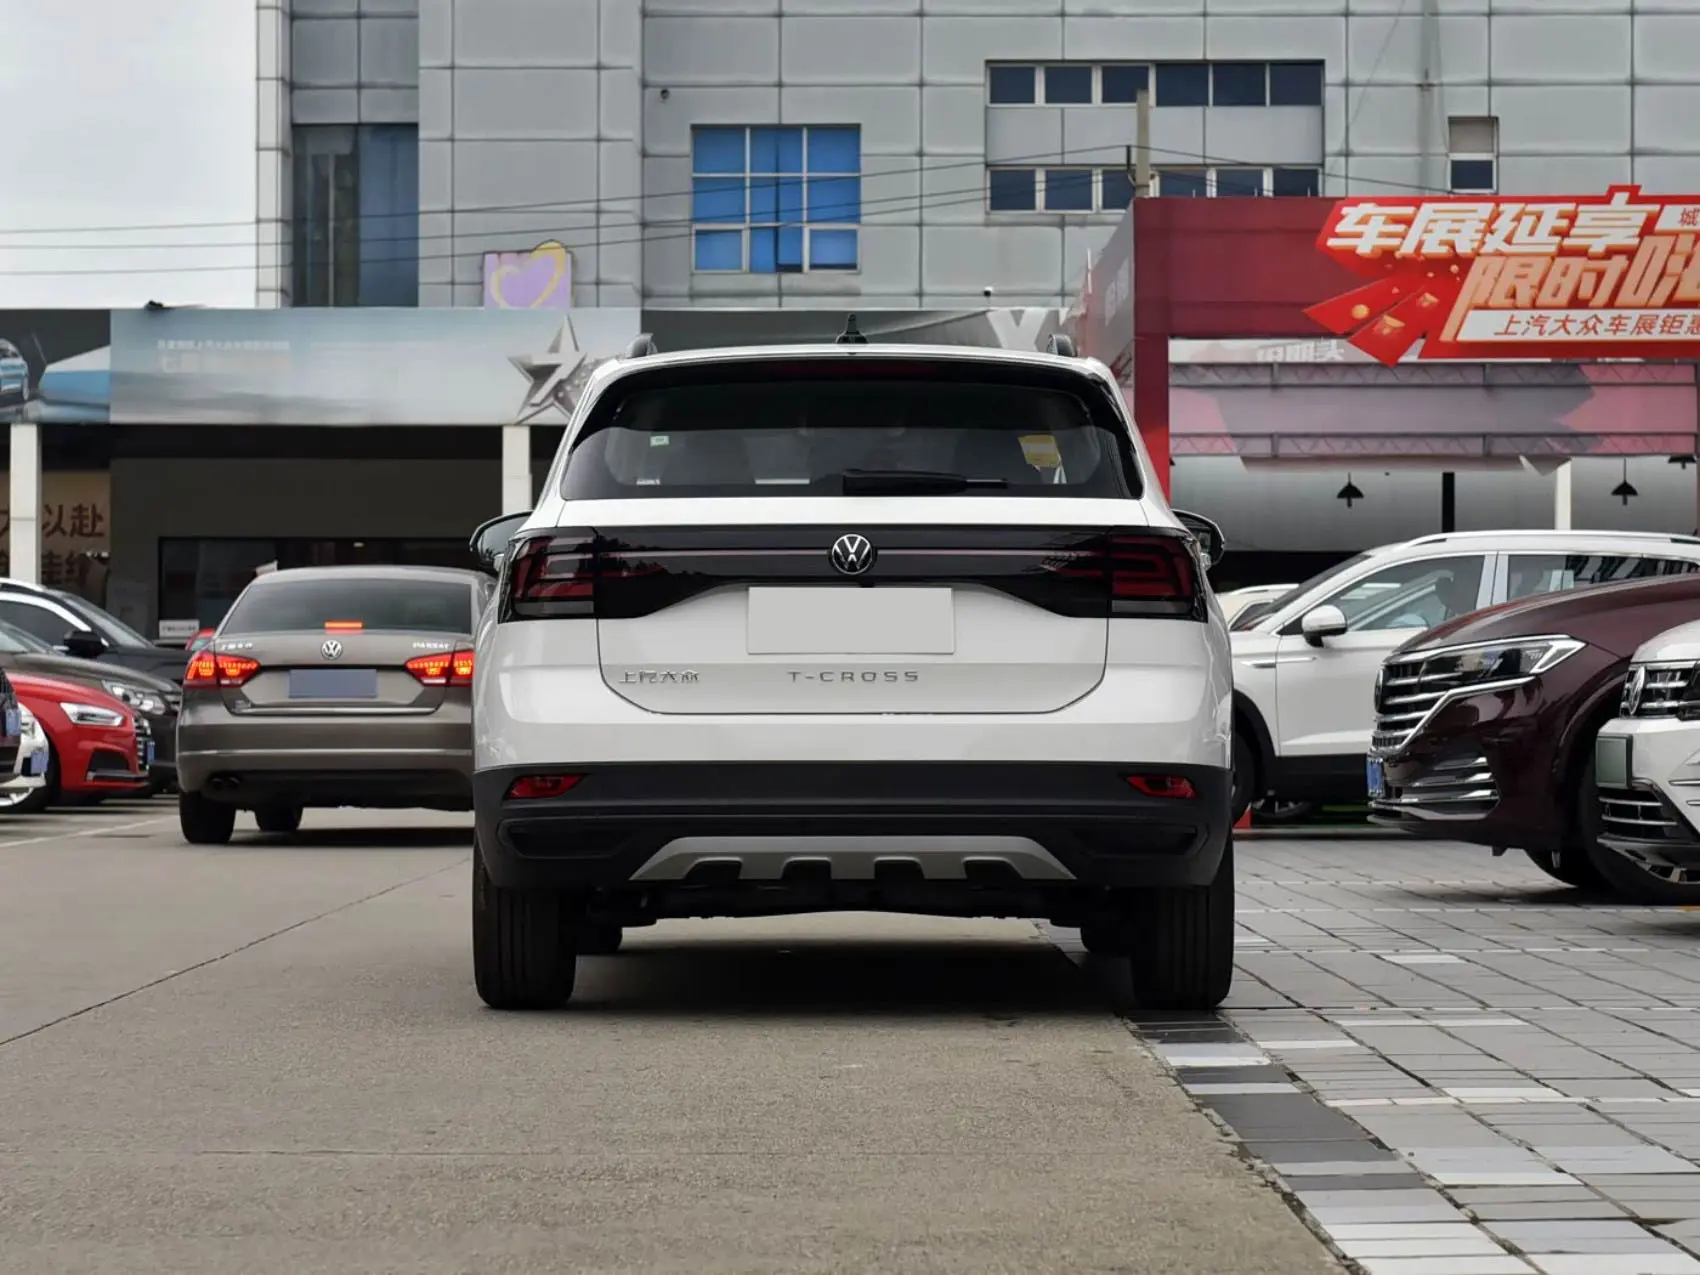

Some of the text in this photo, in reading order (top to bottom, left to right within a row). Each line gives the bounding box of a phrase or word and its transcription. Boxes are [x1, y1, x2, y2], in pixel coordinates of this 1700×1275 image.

[1327, 191, 1661, 255] 车展延享
[787, 671, 919, 682] T-CROSS
